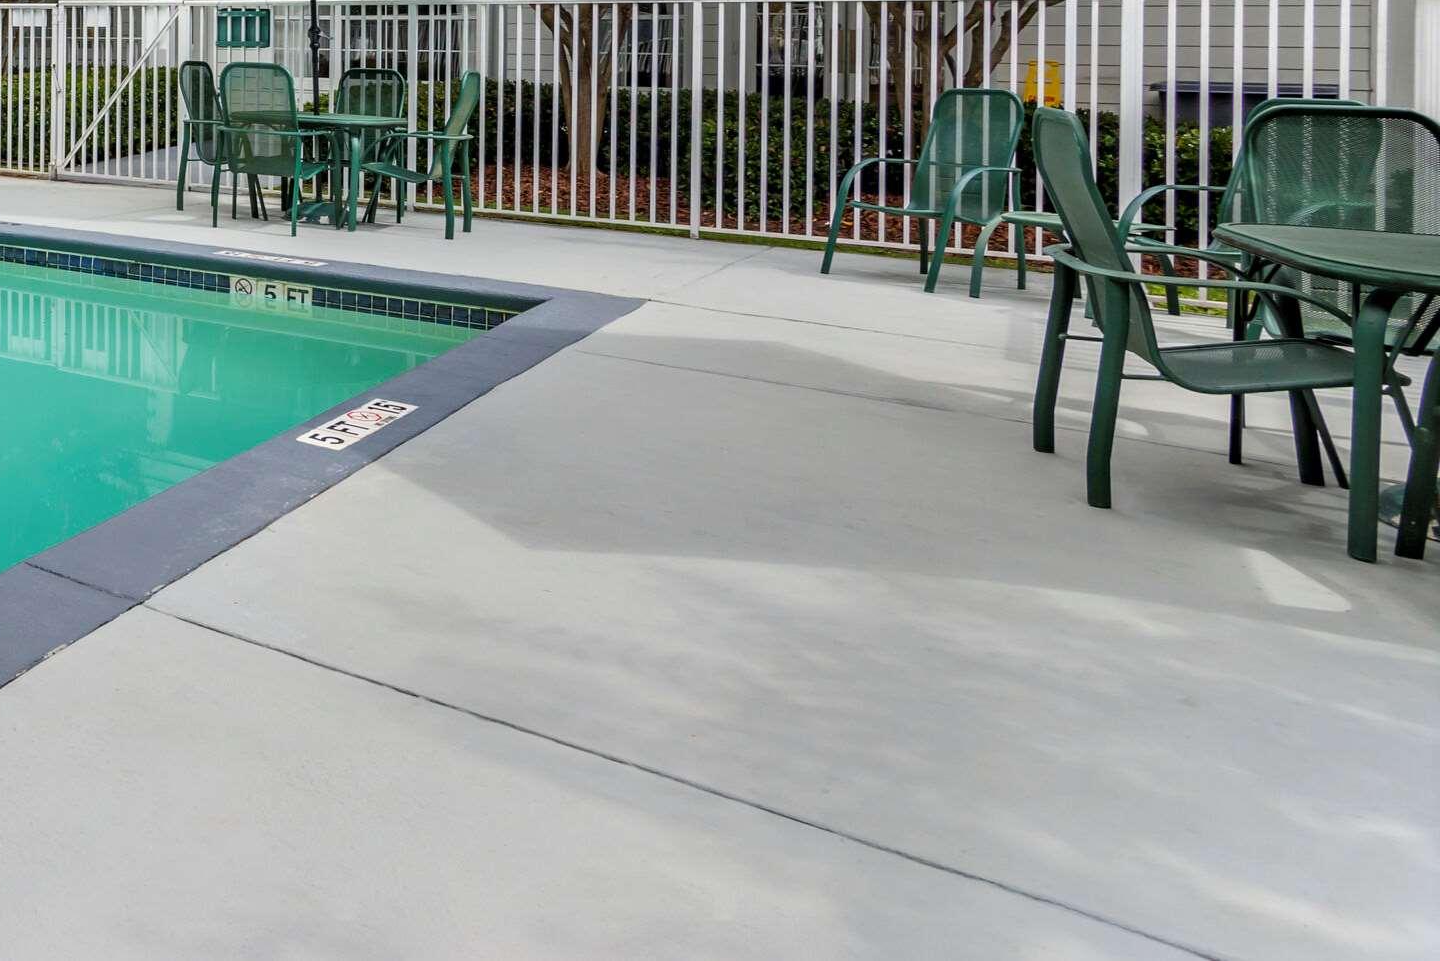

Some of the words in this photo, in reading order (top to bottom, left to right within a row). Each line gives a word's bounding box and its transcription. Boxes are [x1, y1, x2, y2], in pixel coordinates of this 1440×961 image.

[264, 284, 277, 300] 5
[287, 287, 309, 304] FT
[326, 420, 370, 436] FT
[308, 433, 345, 445] 5
